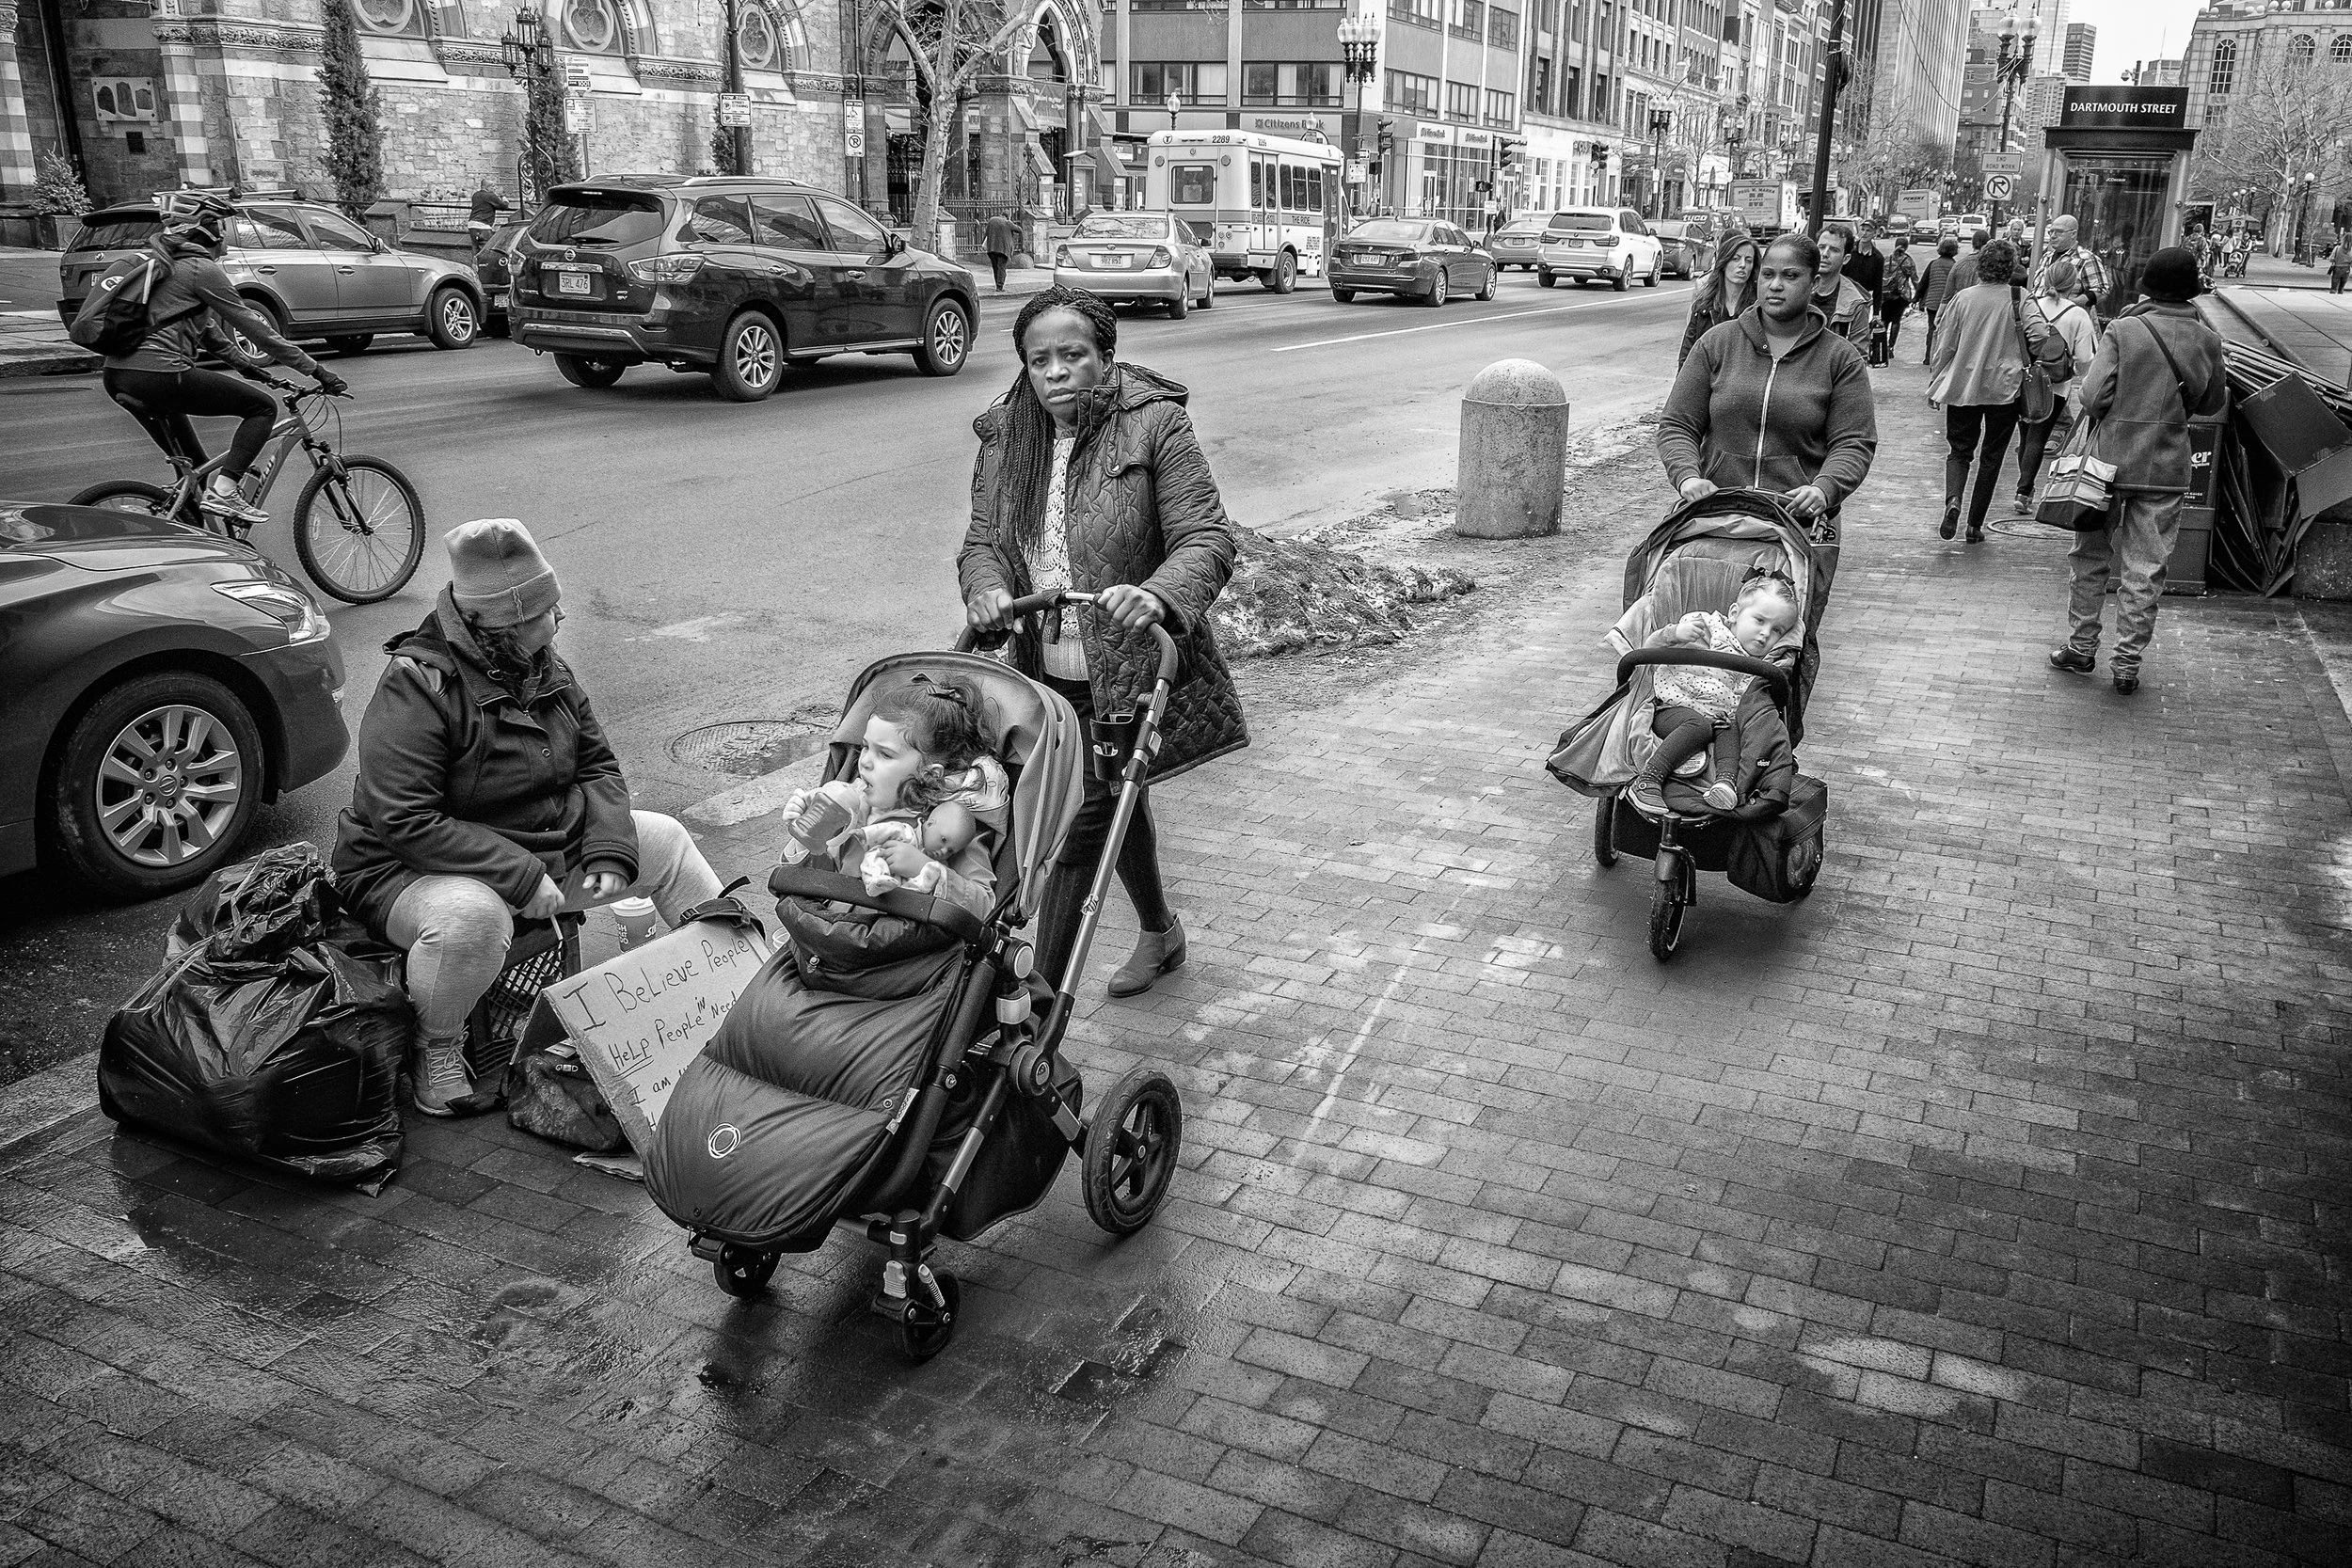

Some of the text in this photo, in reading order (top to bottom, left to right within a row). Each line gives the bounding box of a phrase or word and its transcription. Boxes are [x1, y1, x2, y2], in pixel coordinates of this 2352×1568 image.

[2070, 103, 2177, 114] DARTMOUTH STREET
[1264, 119, 1300, 129] Citizens
[1212, 135, 1231, 144] 2289
[1292, 215, 1311, 225] THE RIDE
[561, 277, 589, 290] 3RL 476
[563, 982, 607, 1032] I
[628, 1084, 646, 1106] I
